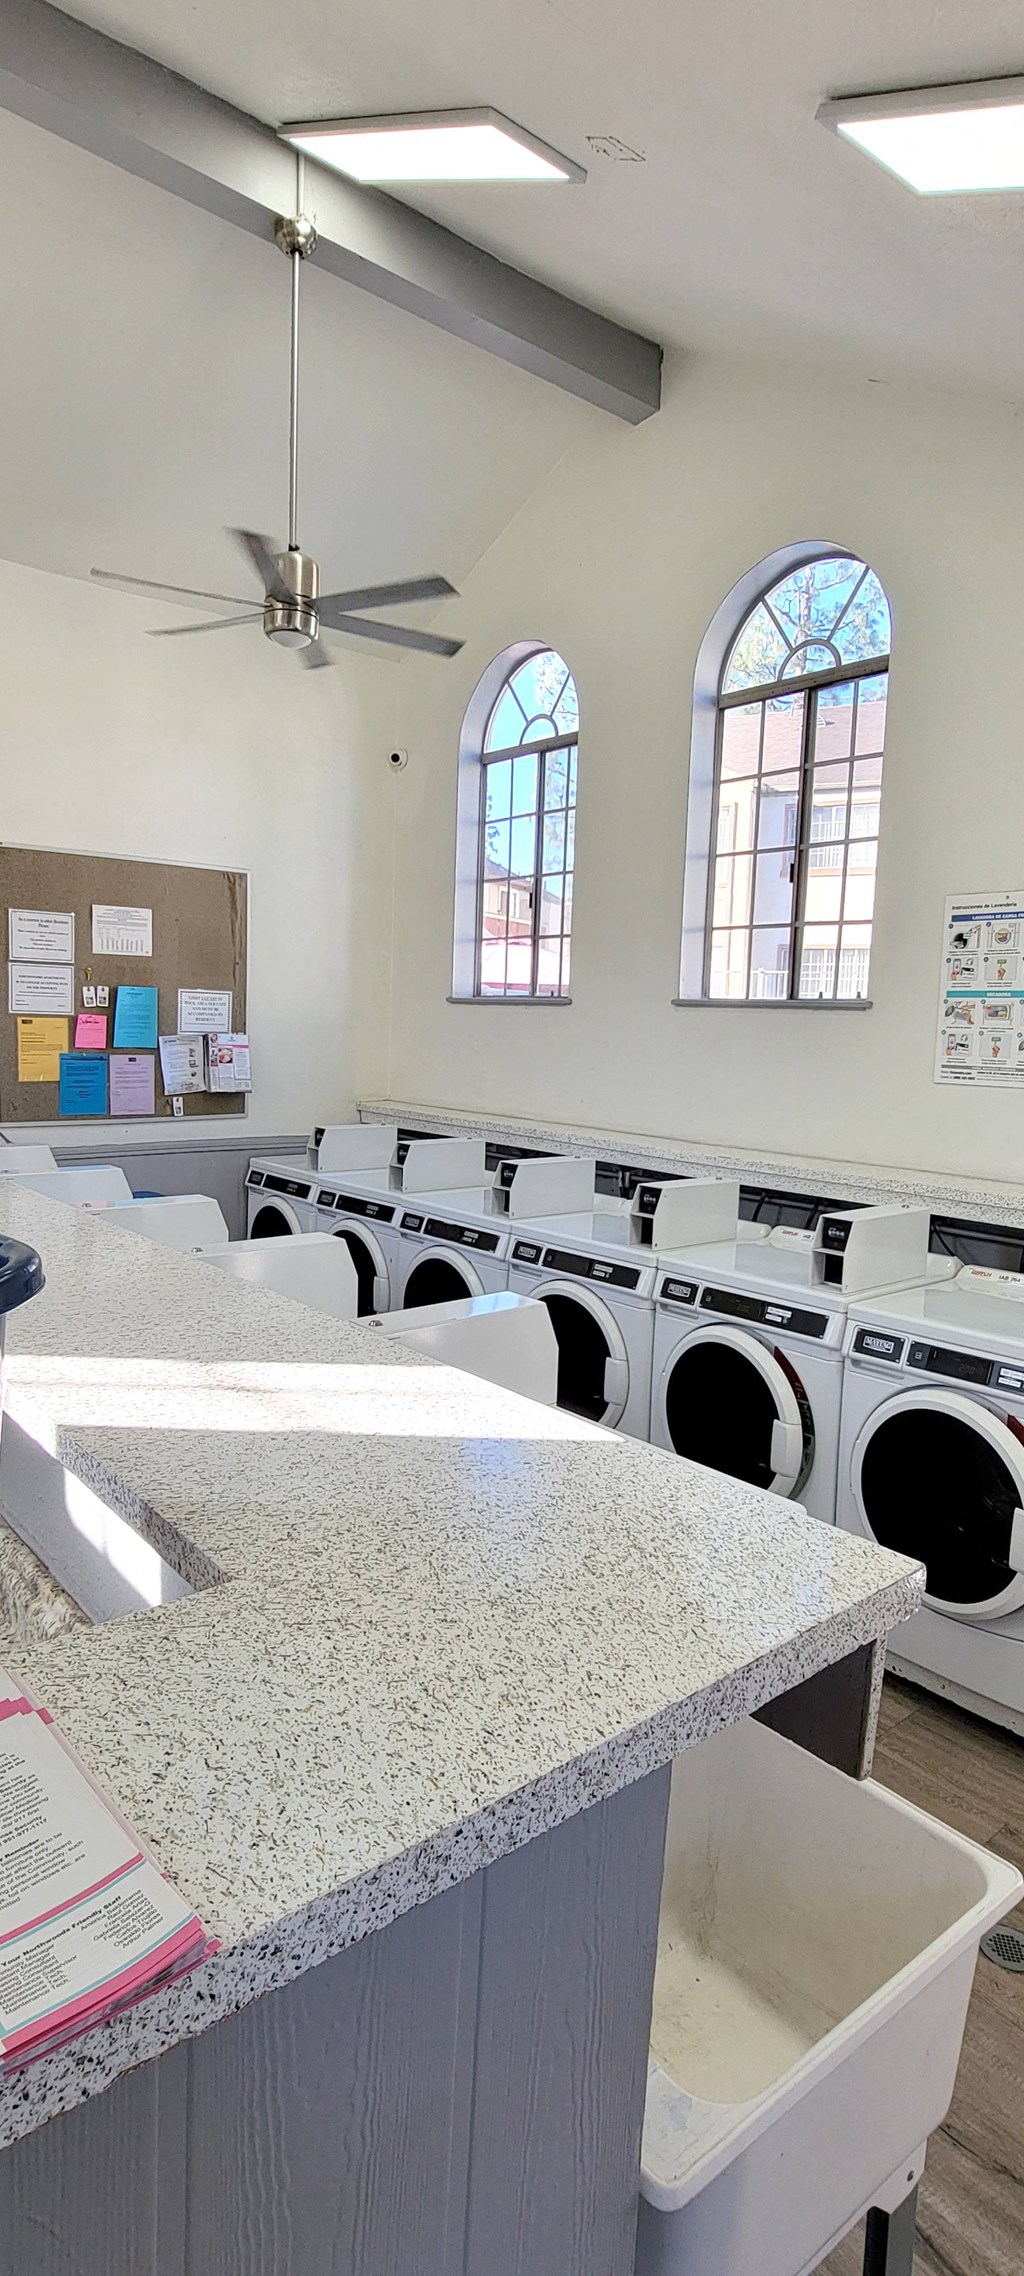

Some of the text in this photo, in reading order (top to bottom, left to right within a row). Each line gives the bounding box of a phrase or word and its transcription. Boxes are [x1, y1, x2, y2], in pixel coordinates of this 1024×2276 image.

[971, 1268, 993, 1277] WASH
[864, 1336, 894, 1349] MAYTAG
[12, 1792, 24, 1800] you
[14, 1777, 39, 1792] suggest
[15, 1794, 40, 1810] Medical
[2, 1817, 48, 1844] 951-977-1117
[13, 1814, 26, 1823] 911
[14, 1815, 43, 1832] Security
[0, 1849, 33, 1868] balconies
[33, 1841, 46, 1850] are
[4, 1838, 40, 1858] Reminder
[5, 1846, 49, 1872] furniture only
[13, 1861, 34, 1875] affect
[33, 1855, 45, 1864] the
[45, 1839, 73, 1858] outward
[14, 1872, 27, 1881] the
[67, 1840, 85, 1852] such
[7, 1890, 20, 1899] foil
[20, 1885, 30, 1893] on
[30, 1869, 61, 1887] windows
[74, 1853, 86, 1862] are
[10, 1872, 40, 1892] personal
[40, 1858, 66, 1874] window
[80, 1889, 142, 1931] America Balderrama
[107, 1893, 145, 1921] Raul Gomez
[132, 1897, 148, 1910] Arias
[1, 1895, 122, 1967] Your Northwoods Friendly Staff
[93, 1922, 121, 1941] Gabriela
[103, 1904, 155, 1941] Federico Alvarez
[113, 1912, 161, 1947] Oswaldo Flores
[116, 1908, 158, 1940] Carlos Trujillo
[122, 1916, 164, 1948] Arthur Palmer
[20, 1952, 50, 1970] Manager
[25, 1943, 55, 1962] Manager
[19, 1954, 57, 1977] Consultant
[22, 1959, 60, 1981] Consultant
[41, 1955, 78, 1977] Supervisor
[46, 1969, 65, 1980] Tech.
[2, 1974, 68, 2010] Maintenance Tech.
[4, 1978, 72, 2015] Maintenance Tech.
